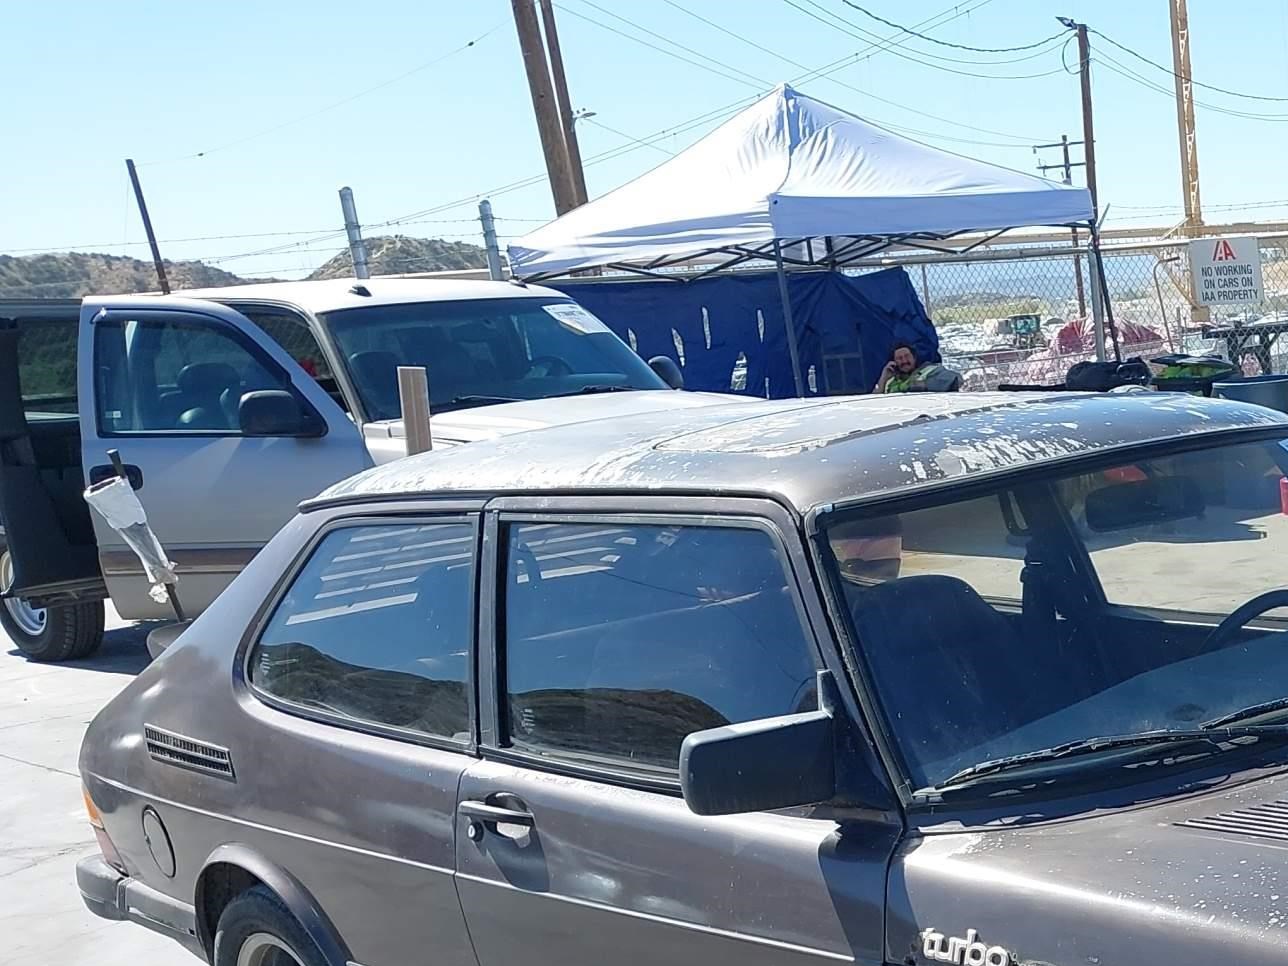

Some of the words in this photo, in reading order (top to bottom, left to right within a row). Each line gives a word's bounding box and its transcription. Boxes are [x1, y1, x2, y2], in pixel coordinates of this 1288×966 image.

[1201, 266, 1213, 277] NO
[1215, 264, 1253, 276] WORKING
[1203, 278, 1215, 289] ON
[1217, 277, 1239, 289] CARS
[1241, 276, 1253, 288] ON
[1202, 290, 1216, 302] IAA
[1217, 289, 1259, 301] PROPERTY
